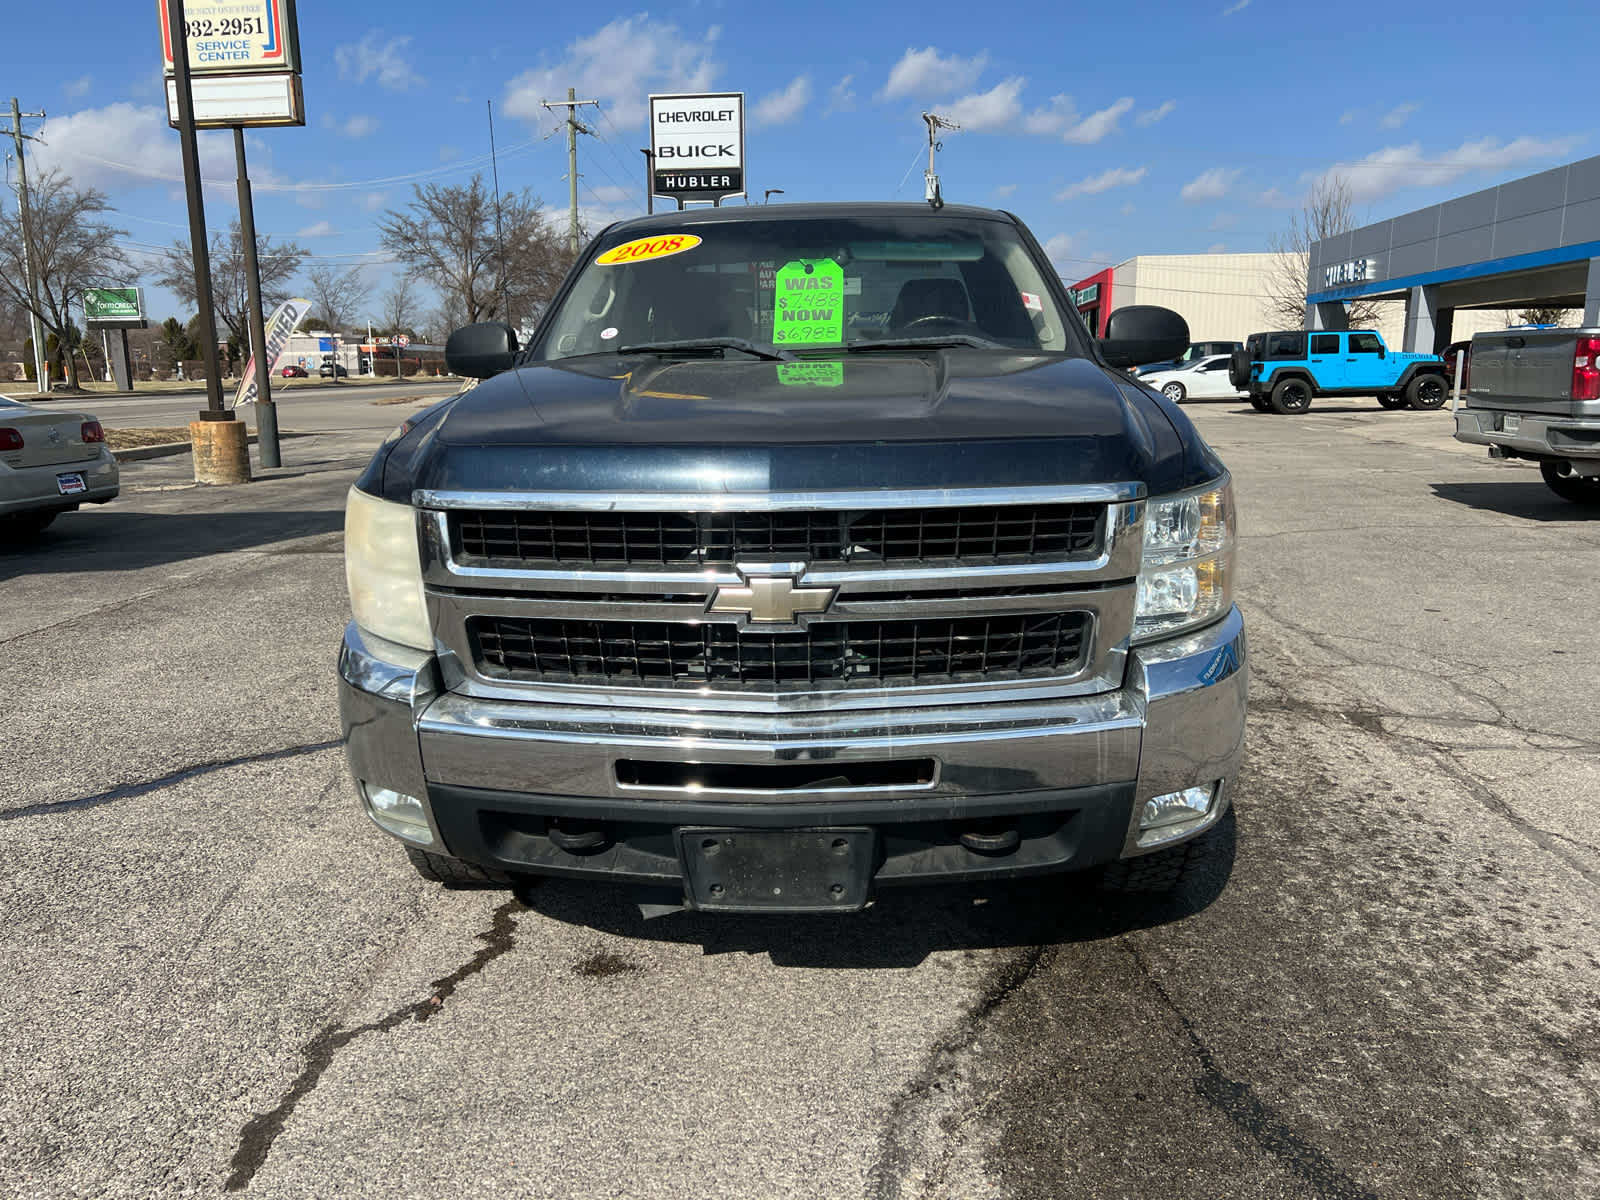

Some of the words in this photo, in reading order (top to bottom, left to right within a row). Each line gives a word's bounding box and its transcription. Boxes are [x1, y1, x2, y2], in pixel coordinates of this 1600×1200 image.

[196, 40, 251, 52] SERVICE
[198, 50, 250, 62] CENTER
[658, 110, 735, 124] CHEVROLET
[658, 144, 736, 158] BUICK
[666, 175, 730, 188] HUBLER
[612, 237, 685, 262] 2008
[784, 276, 834, 291] WAS
[782, 309, 834, 322] NOW
